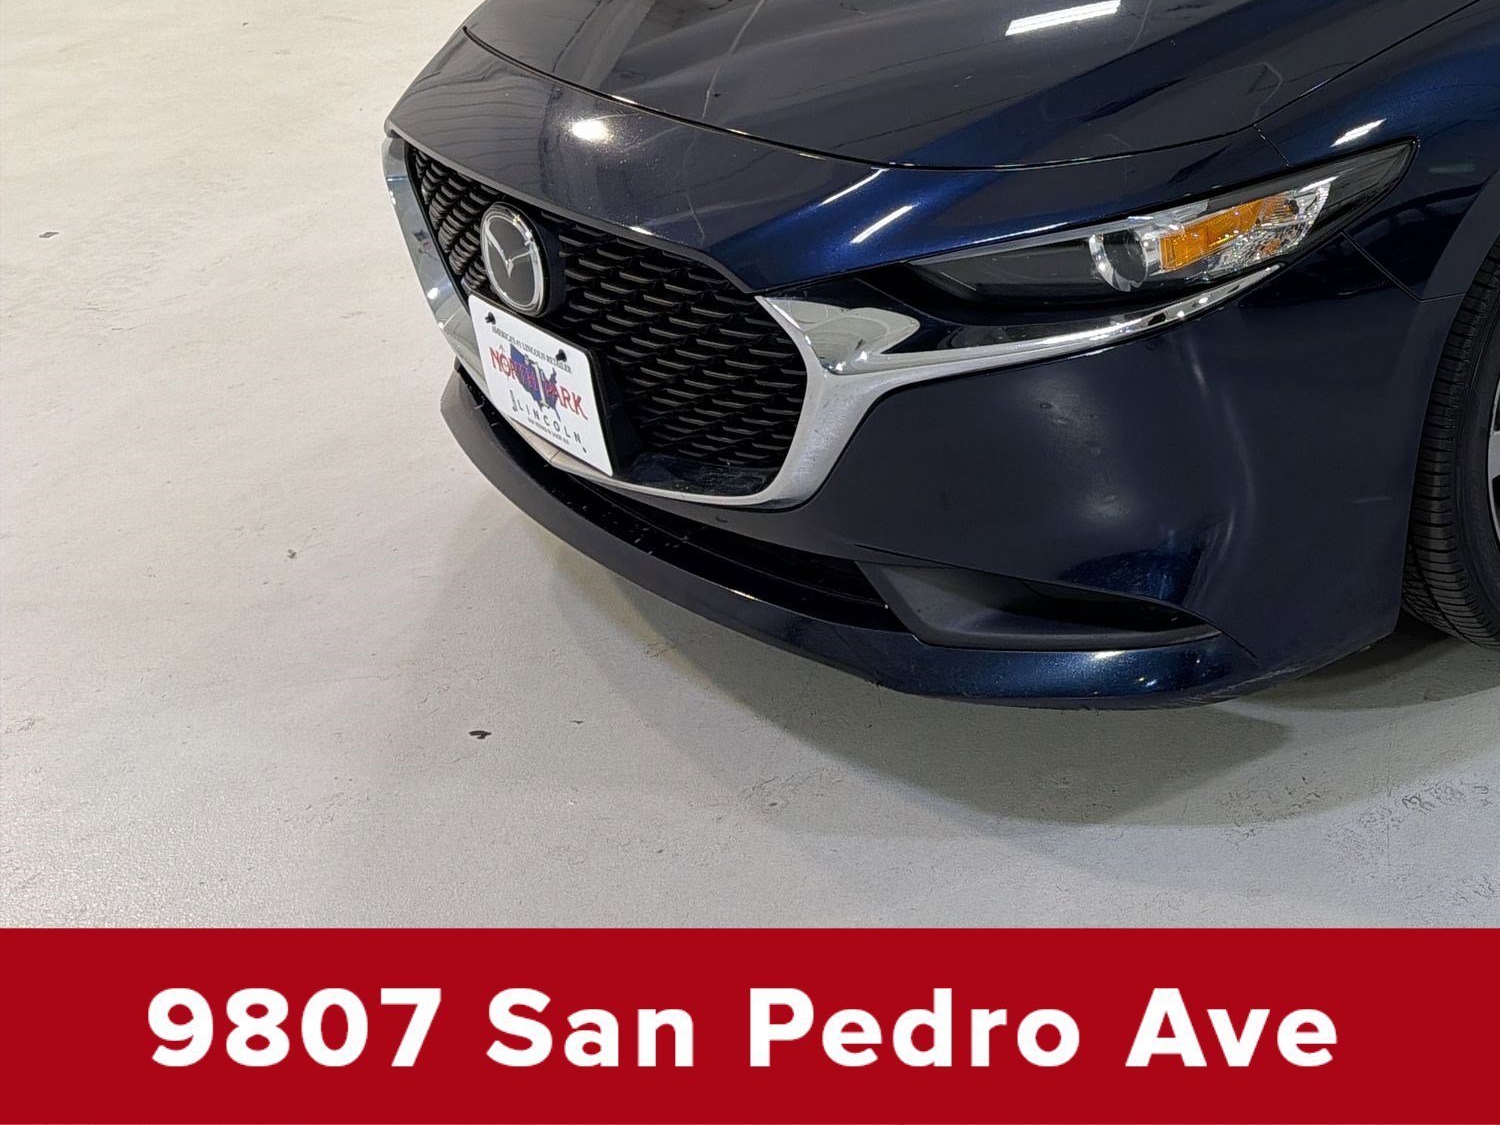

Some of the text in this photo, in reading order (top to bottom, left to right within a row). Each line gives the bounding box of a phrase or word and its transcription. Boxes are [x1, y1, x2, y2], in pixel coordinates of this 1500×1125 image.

[489, 345, 589, 421] NORTH PARK
[517, 399, 582, 444] LINCOLN
